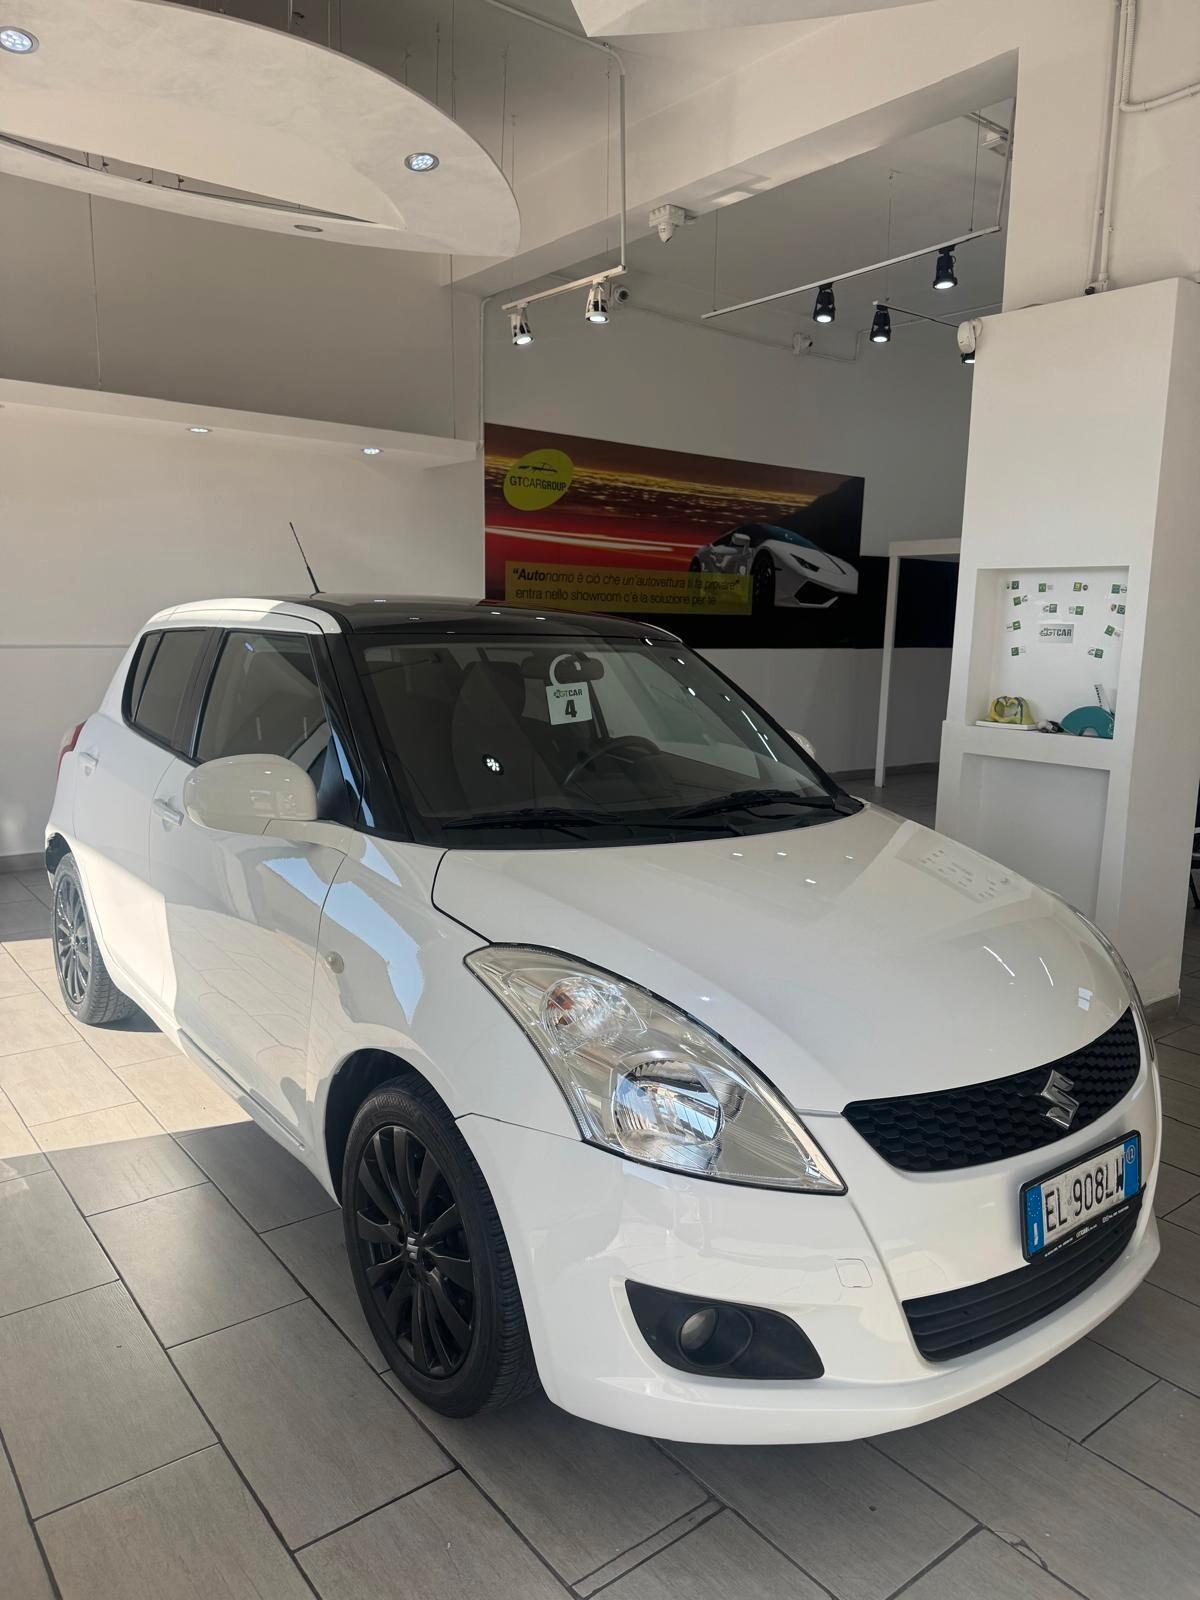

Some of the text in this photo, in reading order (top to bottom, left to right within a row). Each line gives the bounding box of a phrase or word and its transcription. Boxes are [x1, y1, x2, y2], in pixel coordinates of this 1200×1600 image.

[509, 476, 566, 491] GTCARGROUP
[576, 572, 584, 583] è
[603, 573, 621, 585] che
[515, 588, 542, 600] entra
[545, 588, 568, 601] nello
[571, 589, 621, 603] showroom
[640, 592, 648, 603] la
[650, 593, 689, 605] soluzione
[692, 595, 704, 608] per
[559, 688, 583, 699] GTCAR
[565, 699, 578, 718] 4
[1044, 1187, 1068, 1232] EL
[1072, 1156, 1125, 1217] 908LW
